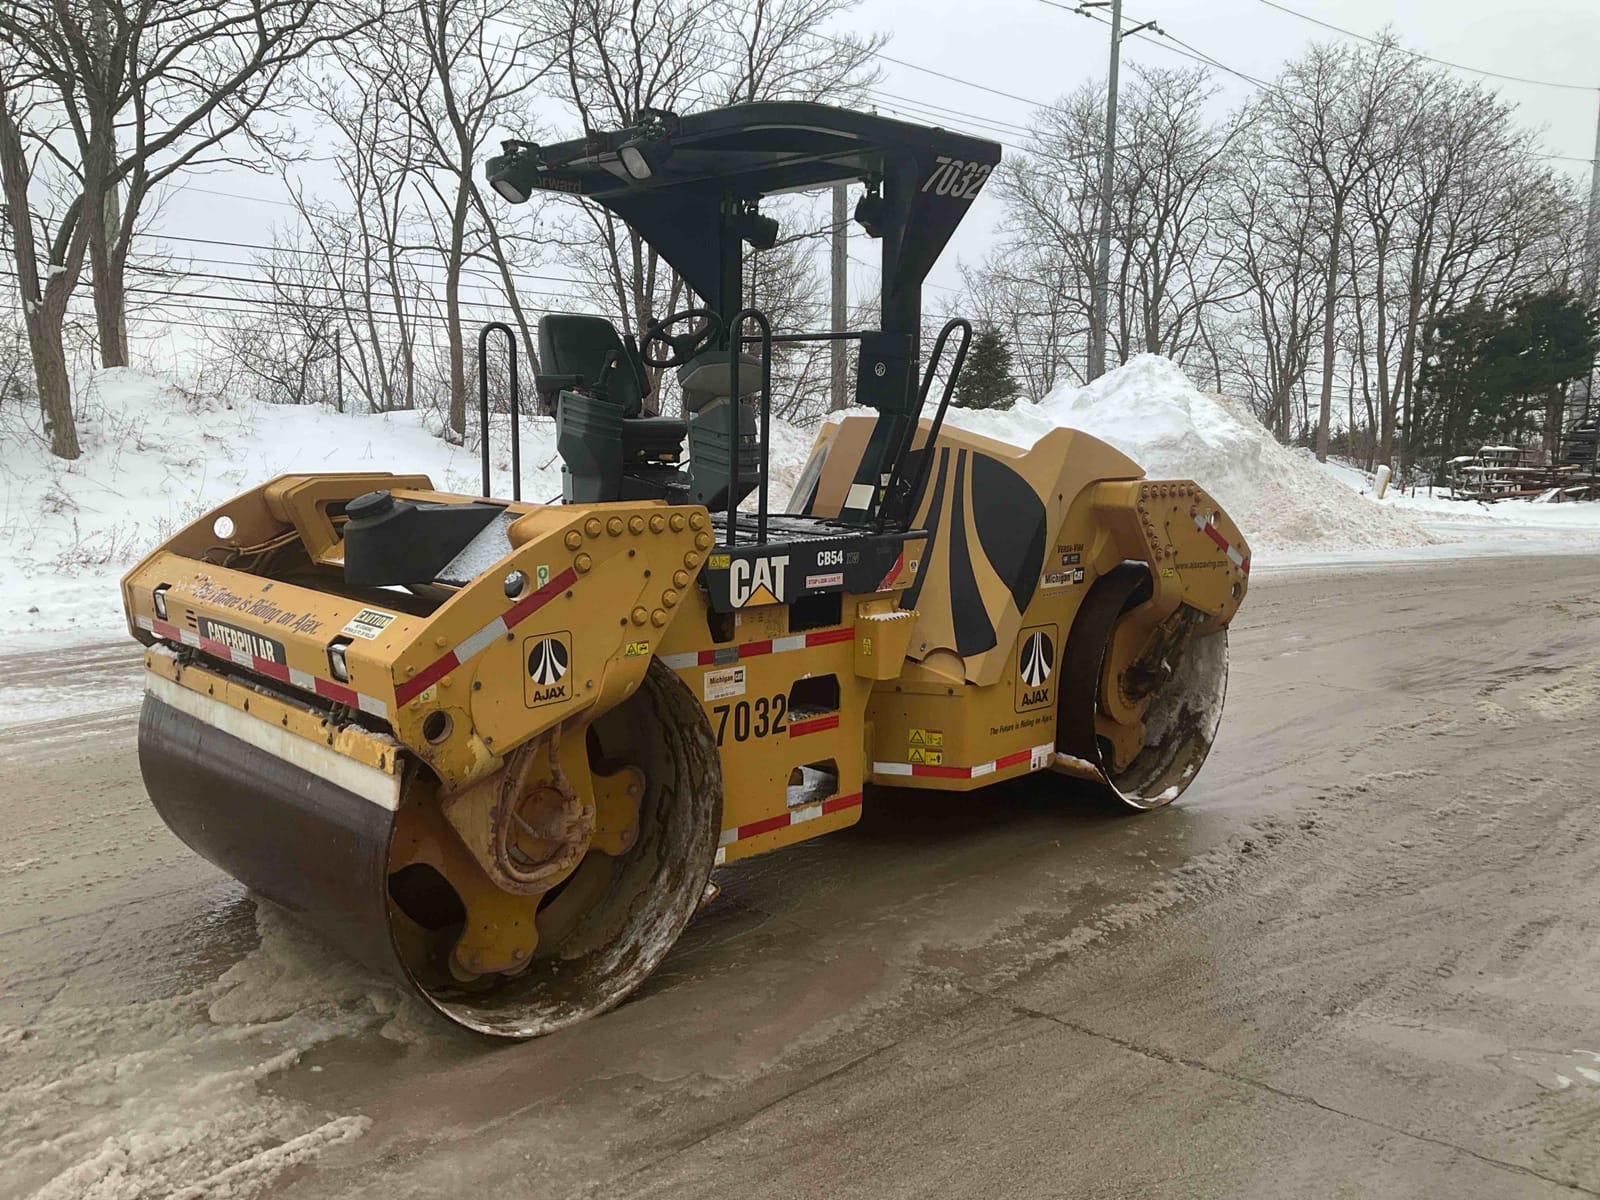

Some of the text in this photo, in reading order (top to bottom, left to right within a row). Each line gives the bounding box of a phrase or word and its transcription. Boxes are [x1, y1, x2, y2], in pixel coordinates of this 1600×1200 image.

[921, 155, 992, 199] 7032
[817, 550, 844, 566] CB54
[730, 555, 789, 608] CAT
[1044, 571, 1071, 584] Michigan
[237, 595, 252, 611] is
[246, 598, 281, 624] Riding
[276, 611, 297, 625] on
[207, 621, 275, 662] CATERPILLAR
[709, 674, 733, 684] Michigan
[533, 685, 565, 702] AJAX
[1022, 689, 1048, 706] AJAX
[713, 693, 786, 747] 7032
